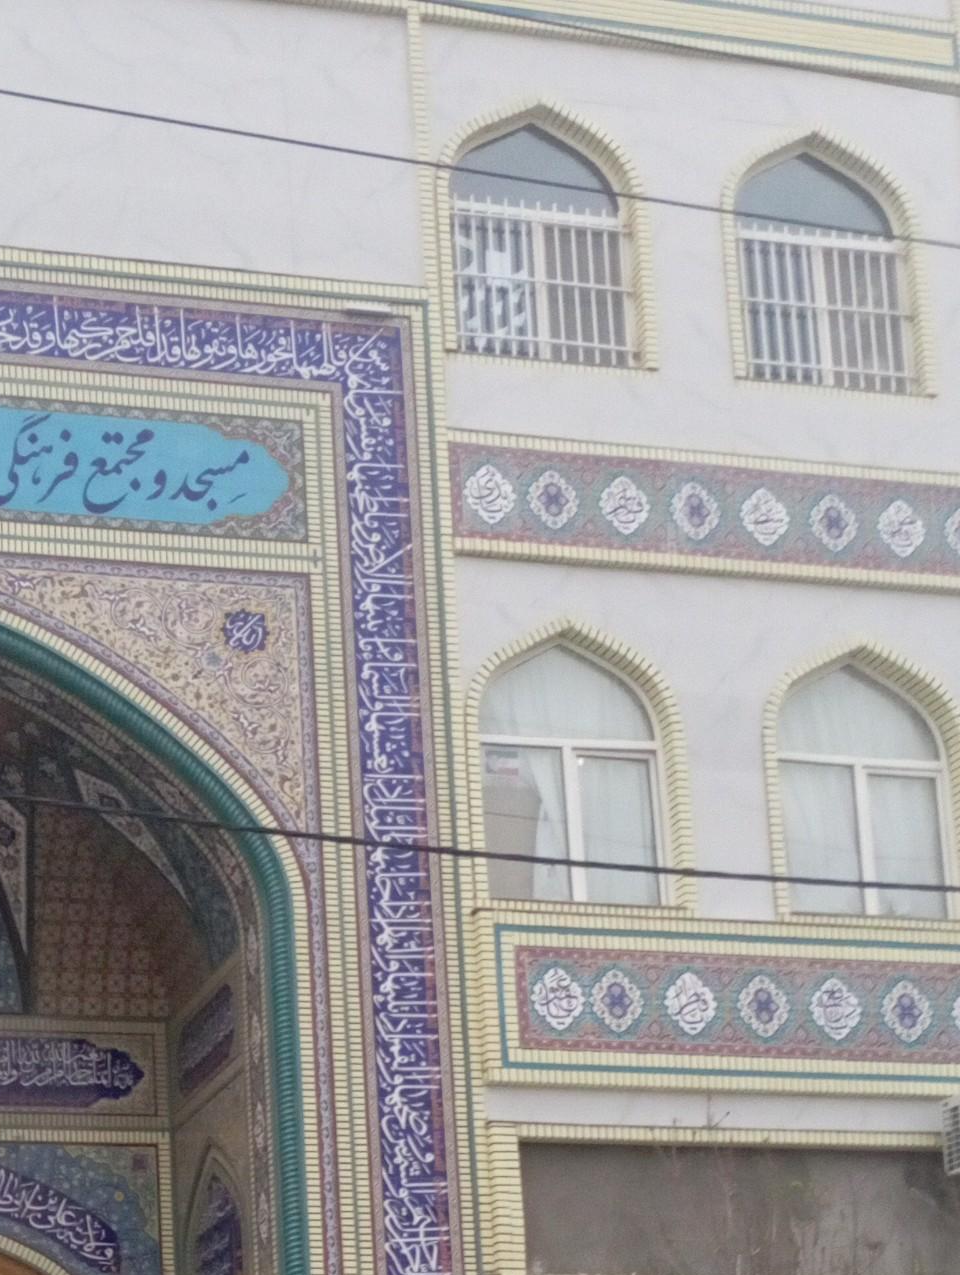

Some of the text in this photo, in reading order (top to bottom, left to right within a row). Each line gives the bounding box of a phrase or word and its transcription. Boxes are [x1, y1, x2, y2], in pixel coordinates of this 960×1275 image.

[81, 427, 156, 514] مجتمع
[148, 466, 170, 500] و
[170, 450, 250, 511] مسجد
